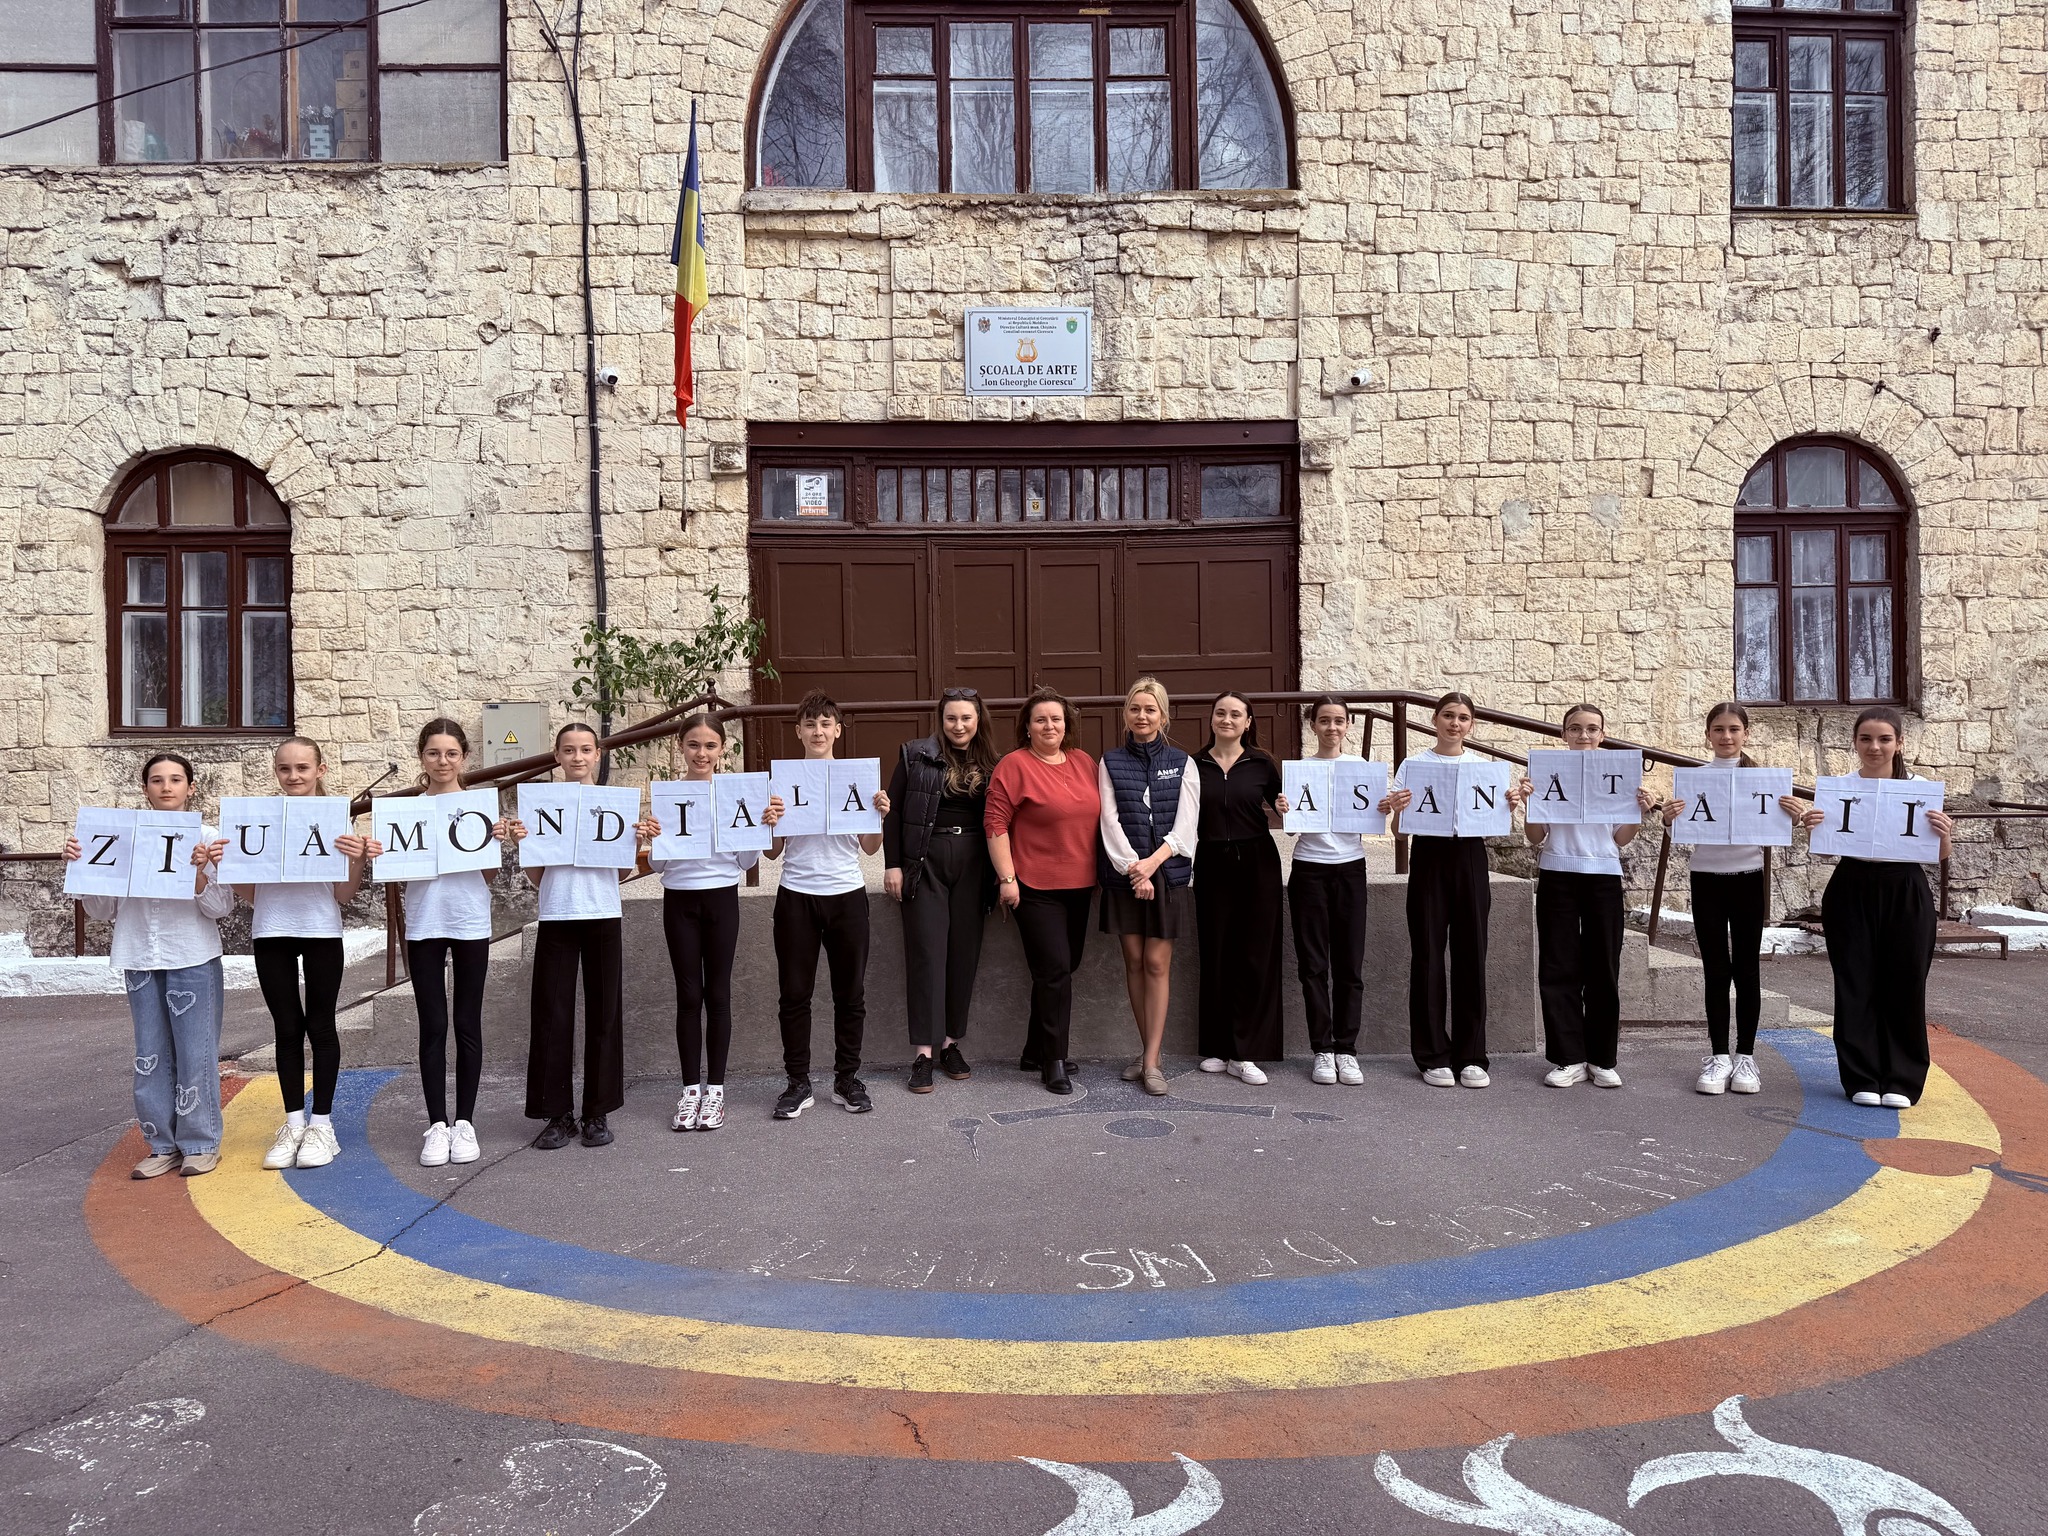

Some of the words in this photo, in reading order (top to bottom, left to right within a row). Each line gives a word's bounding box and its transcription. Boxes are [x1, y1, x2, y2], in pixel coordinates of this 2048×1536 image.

[980, 365, 1024, 377] ȘCOALA
[1028, 365, 1043, 375] DE
[1047, 365, 1077, 375] ARTE
[1000, 378, 1037, 387] Gheorghe
